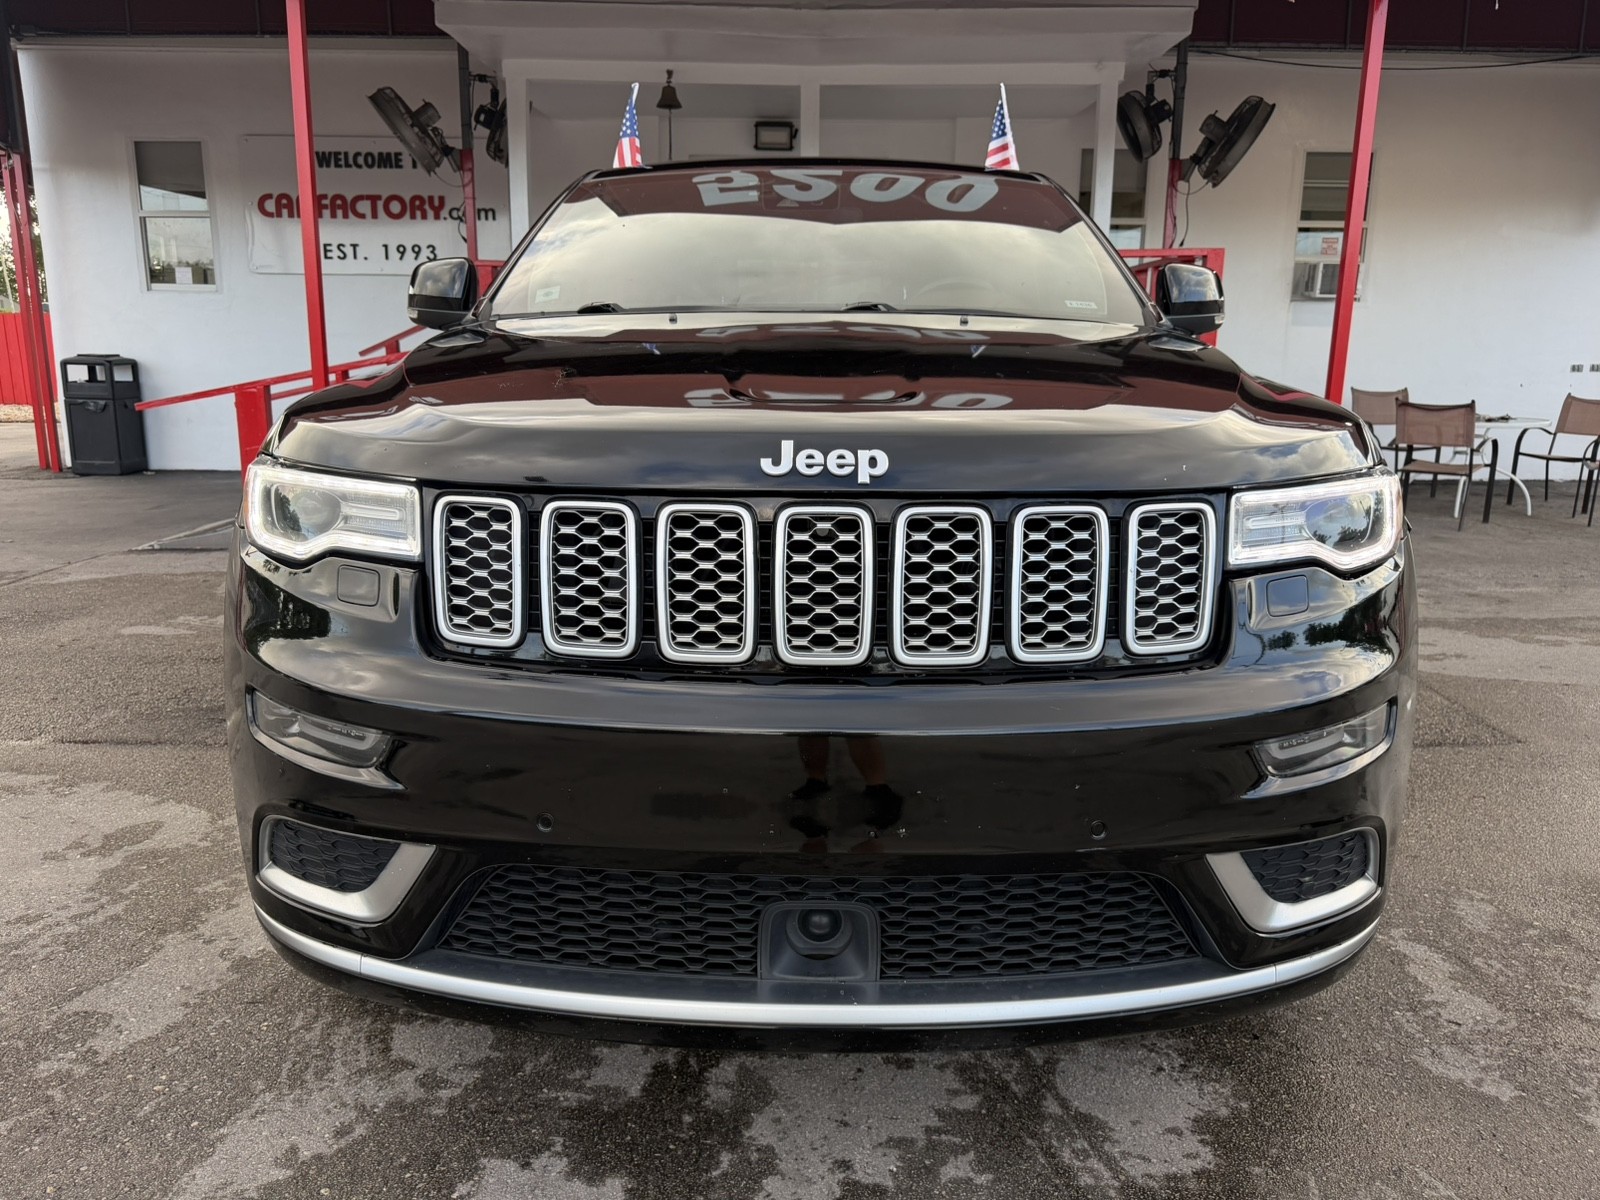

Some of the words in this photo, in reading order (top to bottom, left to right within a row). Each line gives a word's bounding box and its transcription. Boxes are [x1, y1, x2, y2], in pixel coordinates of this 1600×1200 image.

[314, 151, 404, 169] WELCOME
[257, 192, 497, 221] CAFACTORY.cm
[322, 243, 369, 261] EST.
[381, 244, 438, 262] 1993
[759, 439, 890, 485] Jeep
